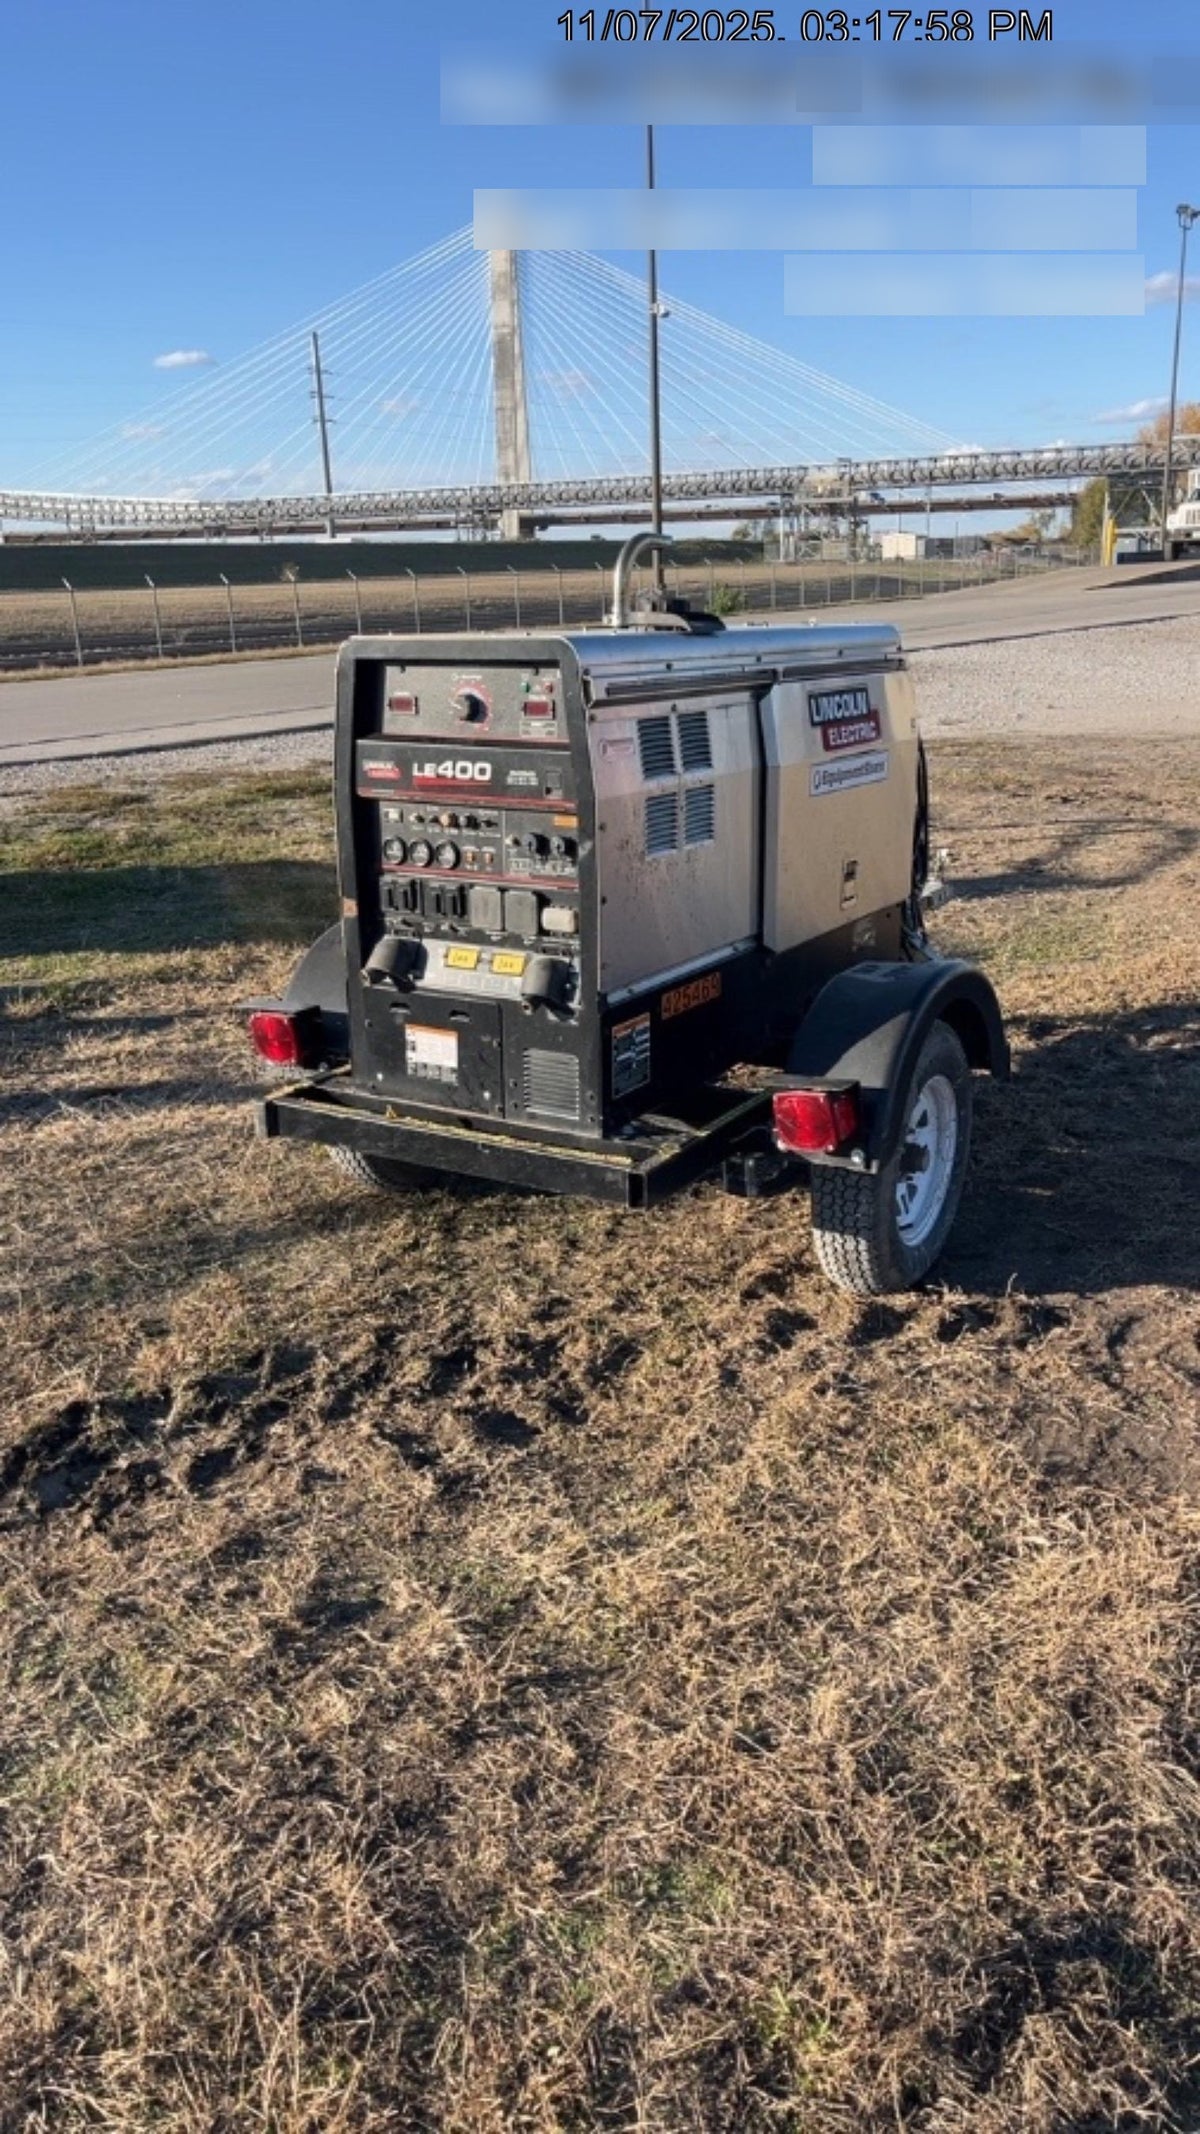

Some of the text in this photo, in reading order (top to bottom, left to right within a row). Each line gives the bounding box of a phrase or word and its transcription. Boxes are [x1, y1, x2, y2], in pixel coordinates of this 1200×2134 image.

[810, 691, 867, 723] LINCOLN
[828, 721, 877, 746] ELECTRIC
[412, 760, 493, 781] LE400
